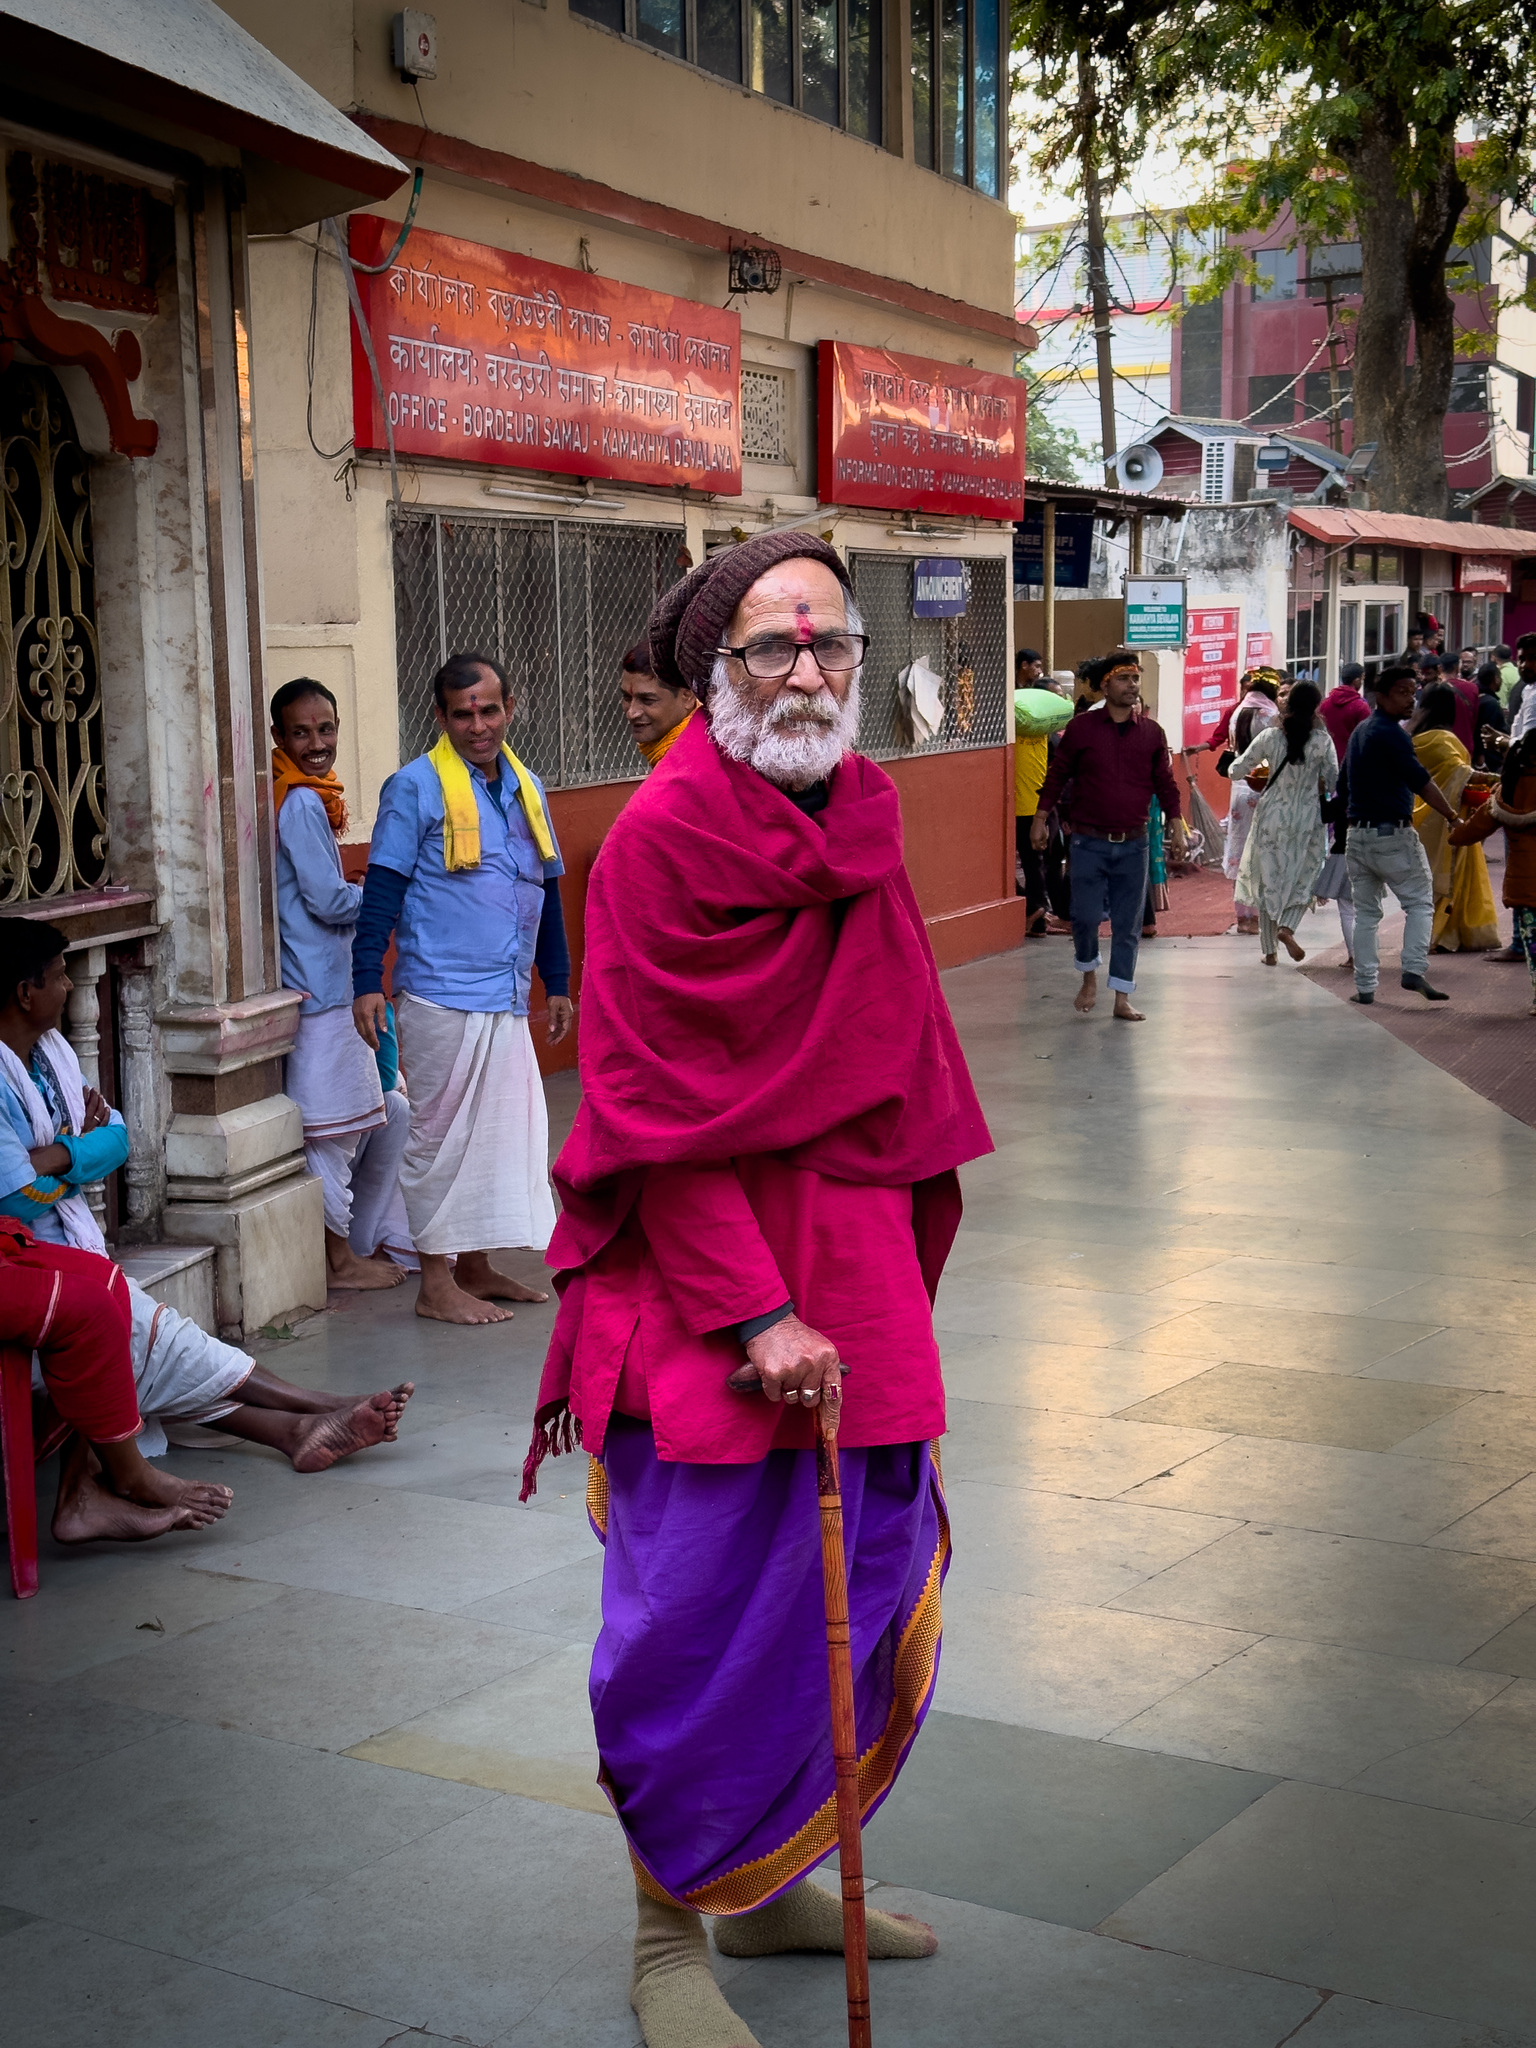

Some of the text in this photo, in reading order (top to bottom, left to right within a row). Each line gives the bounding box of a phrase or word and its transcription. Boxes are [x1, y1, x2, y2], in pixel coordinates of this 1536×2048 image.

[567, 307, 611, 347] সমাজ
[683, 378, 733, 432] देवालय
[388, 391, 448, 433] OFFICE
[463, 403, 540, 446] BORDEURI
[543, 416, 590, 454] SAMAJ
[602, 426, 673, 466] KAMAKHYA
[674, 438, 733, 474] DEVALAYA
[836, 458, 899, 487] INFORMATION
[901, 466, 935, 491] CENTRE
[941, 472, 984, 497] KAMAKHYA
[985, 477, 1022, 500] DEVALAYA
[1013, 534, 1074, 547] REE IFI
